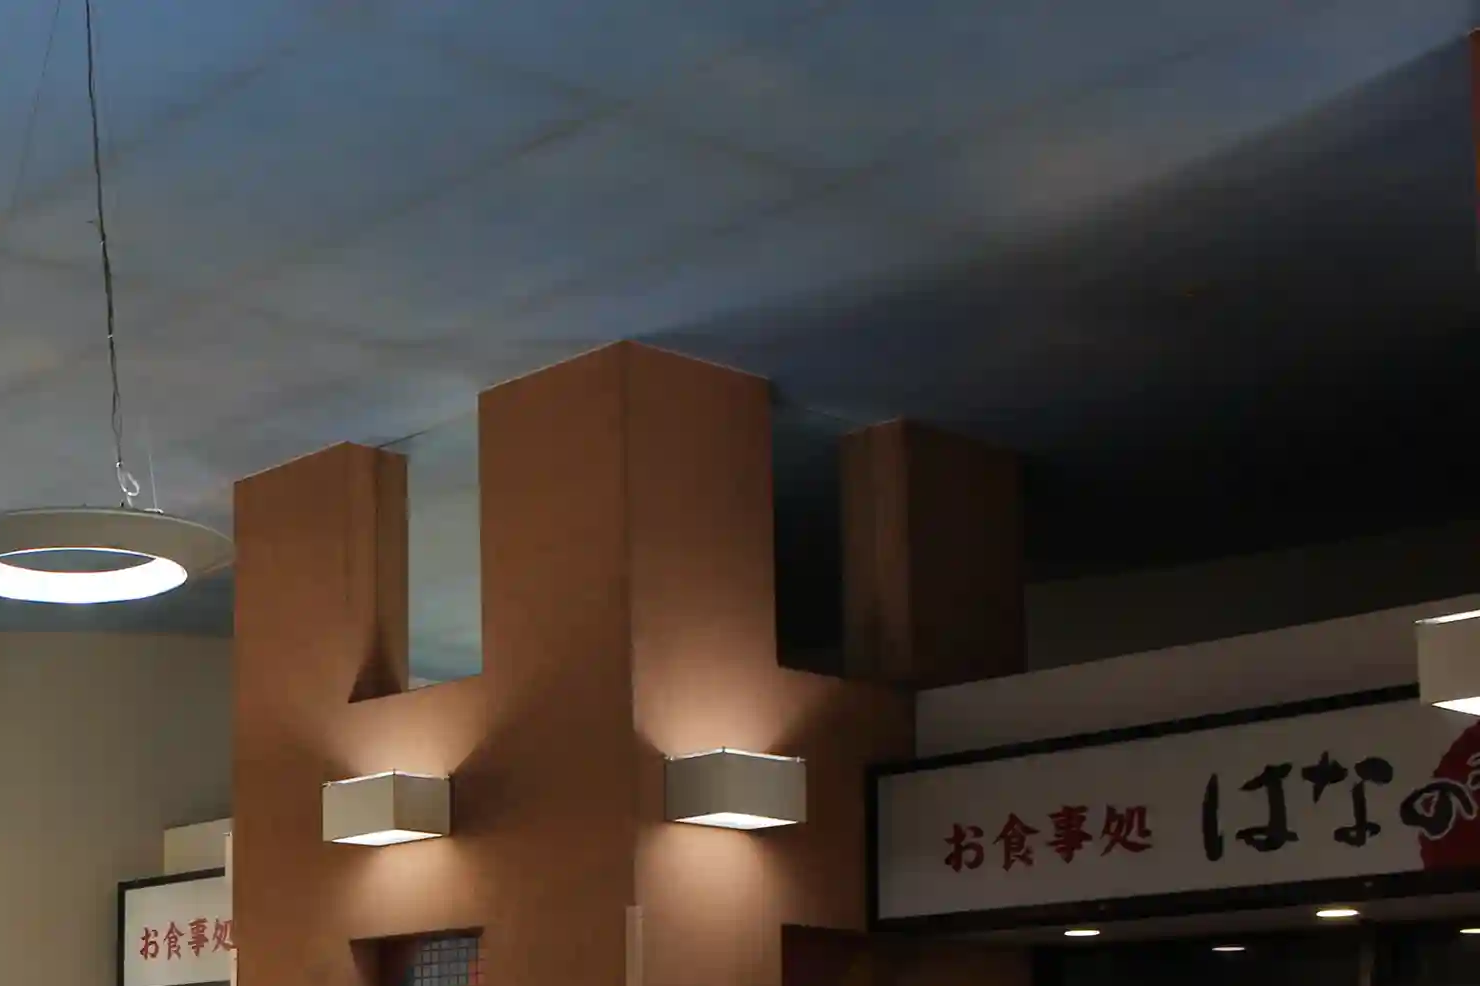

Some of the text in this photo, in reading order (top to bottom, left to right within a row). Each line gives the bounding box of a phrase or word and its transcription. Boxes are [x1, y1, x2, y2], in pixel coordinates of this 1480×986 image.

[944, 749, 1480, 873] お食事処 はなの
[139, 916, 237, 961] お食事処
